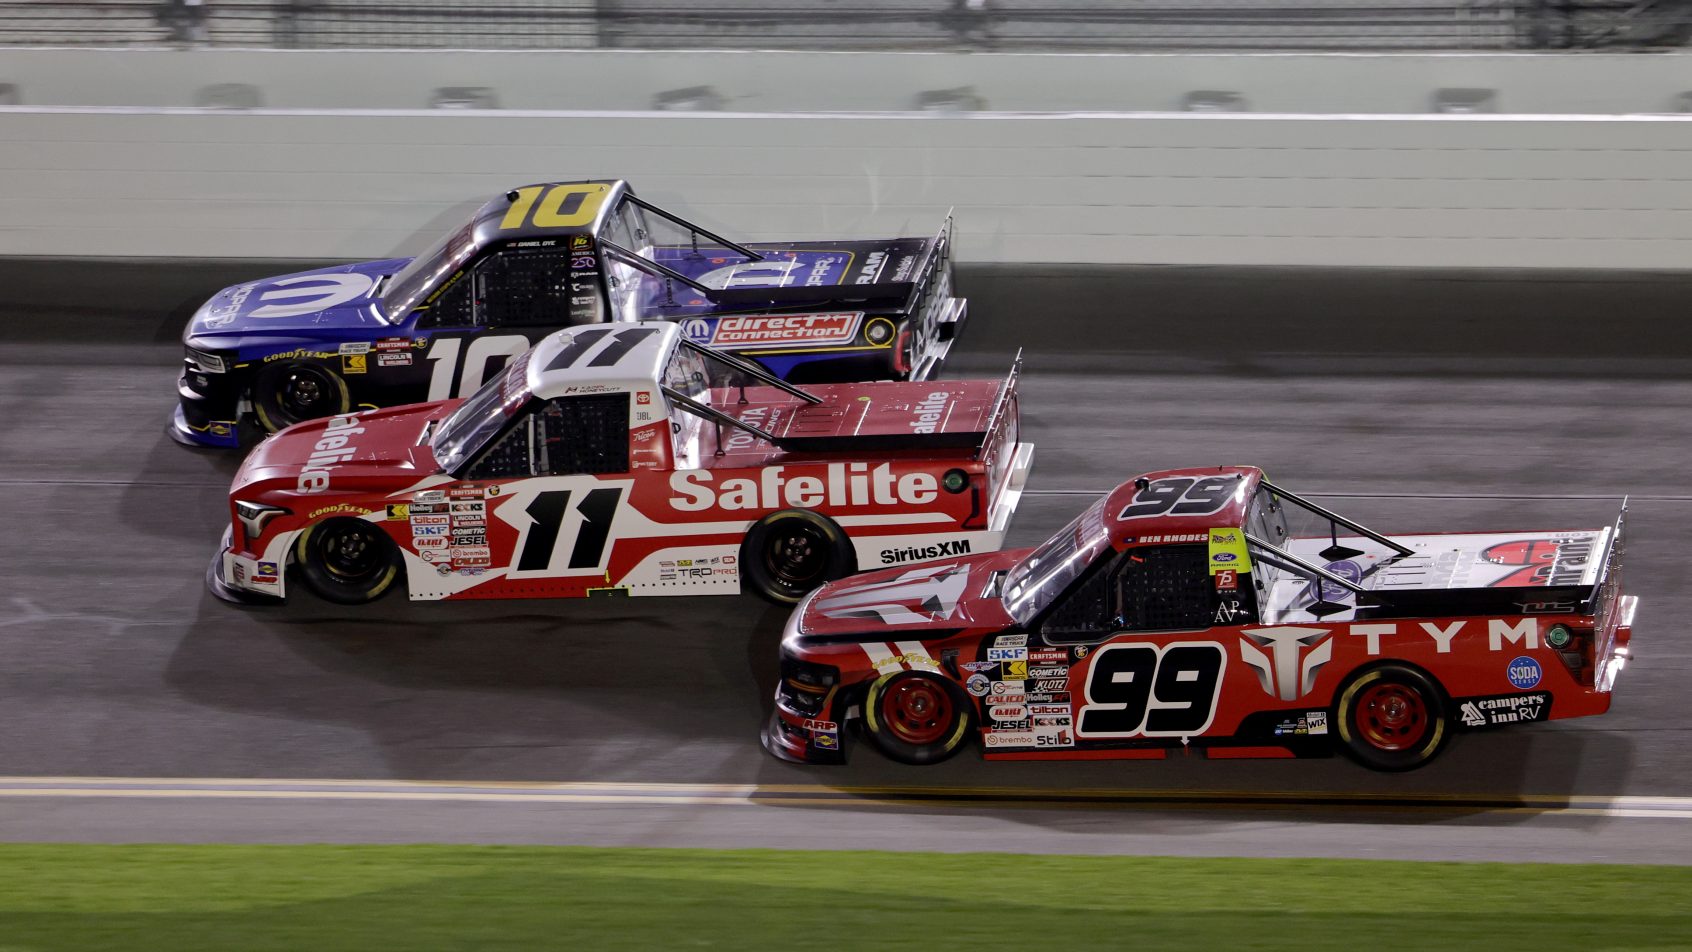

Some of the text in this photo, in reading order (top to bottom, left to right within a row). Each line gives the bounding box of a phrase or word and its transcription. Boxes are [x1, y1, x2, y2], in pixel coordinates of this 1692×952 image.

[500, 184, 611, 229] 10
[570, 256, 596, 269] 250
[855, 251, 886, 285] RAM
[721, 315, 828, 331] direct
[717, 327, 846, 341] connection
[263, 348, 329, 363] GOODYEAR
[543, 329, 660, 372] 11
[636, 411, 652, 421] JBL
[756, 408, 781, 450] RCING
[669, 462, 938, 512] Safelite
[1117, 473, 1241, 521] 99
[308, 503, 372, 519] GOODYEAR
[409, 505, 433, 513] Holley
[451, 503, 483, 512] KOOKS
[413, 516, 448, 524] tilton
[414, 526, 447, 535] SKF
[452, 527, 486, 536] COMETIC
[517, 488, 623, 571] 11
[450, 536, 487, 546] JESEL
[1139, 535, 1162, 543] BEN
[1163, 534, 1209, 543] RHODES
[880, 539, 971, 564] SiriusXM
[1216, 553, 1233, 562] Ford
[678, 567, 713, 579] TRD
[989, 648, 1027, 659] SKF
[1029, 652, 1067, 660] CRAFTSMAN
[1029, 666, 1068, 678] COMETIC
[1510, 666, 1539, 680] SODA
[1036, 679, 1065, 689] KLOTZ
[1077, 642, 1227, 737] 99
[986, 695, 1024, 704] CALICO
[1026, 693, 1053, 703] Holley
[1478, 694, 1544, 711] campers
[1029, 706, 1069, 714] tilton
[1490, 705, 1541, 724] inn RV
[803, 719, 837, 730] ARP
[991, 720, 1032, 730] JESEL
[1034, 717, 1070, 726] KOOKS
[1308, 718, 1326, 729] WIX
